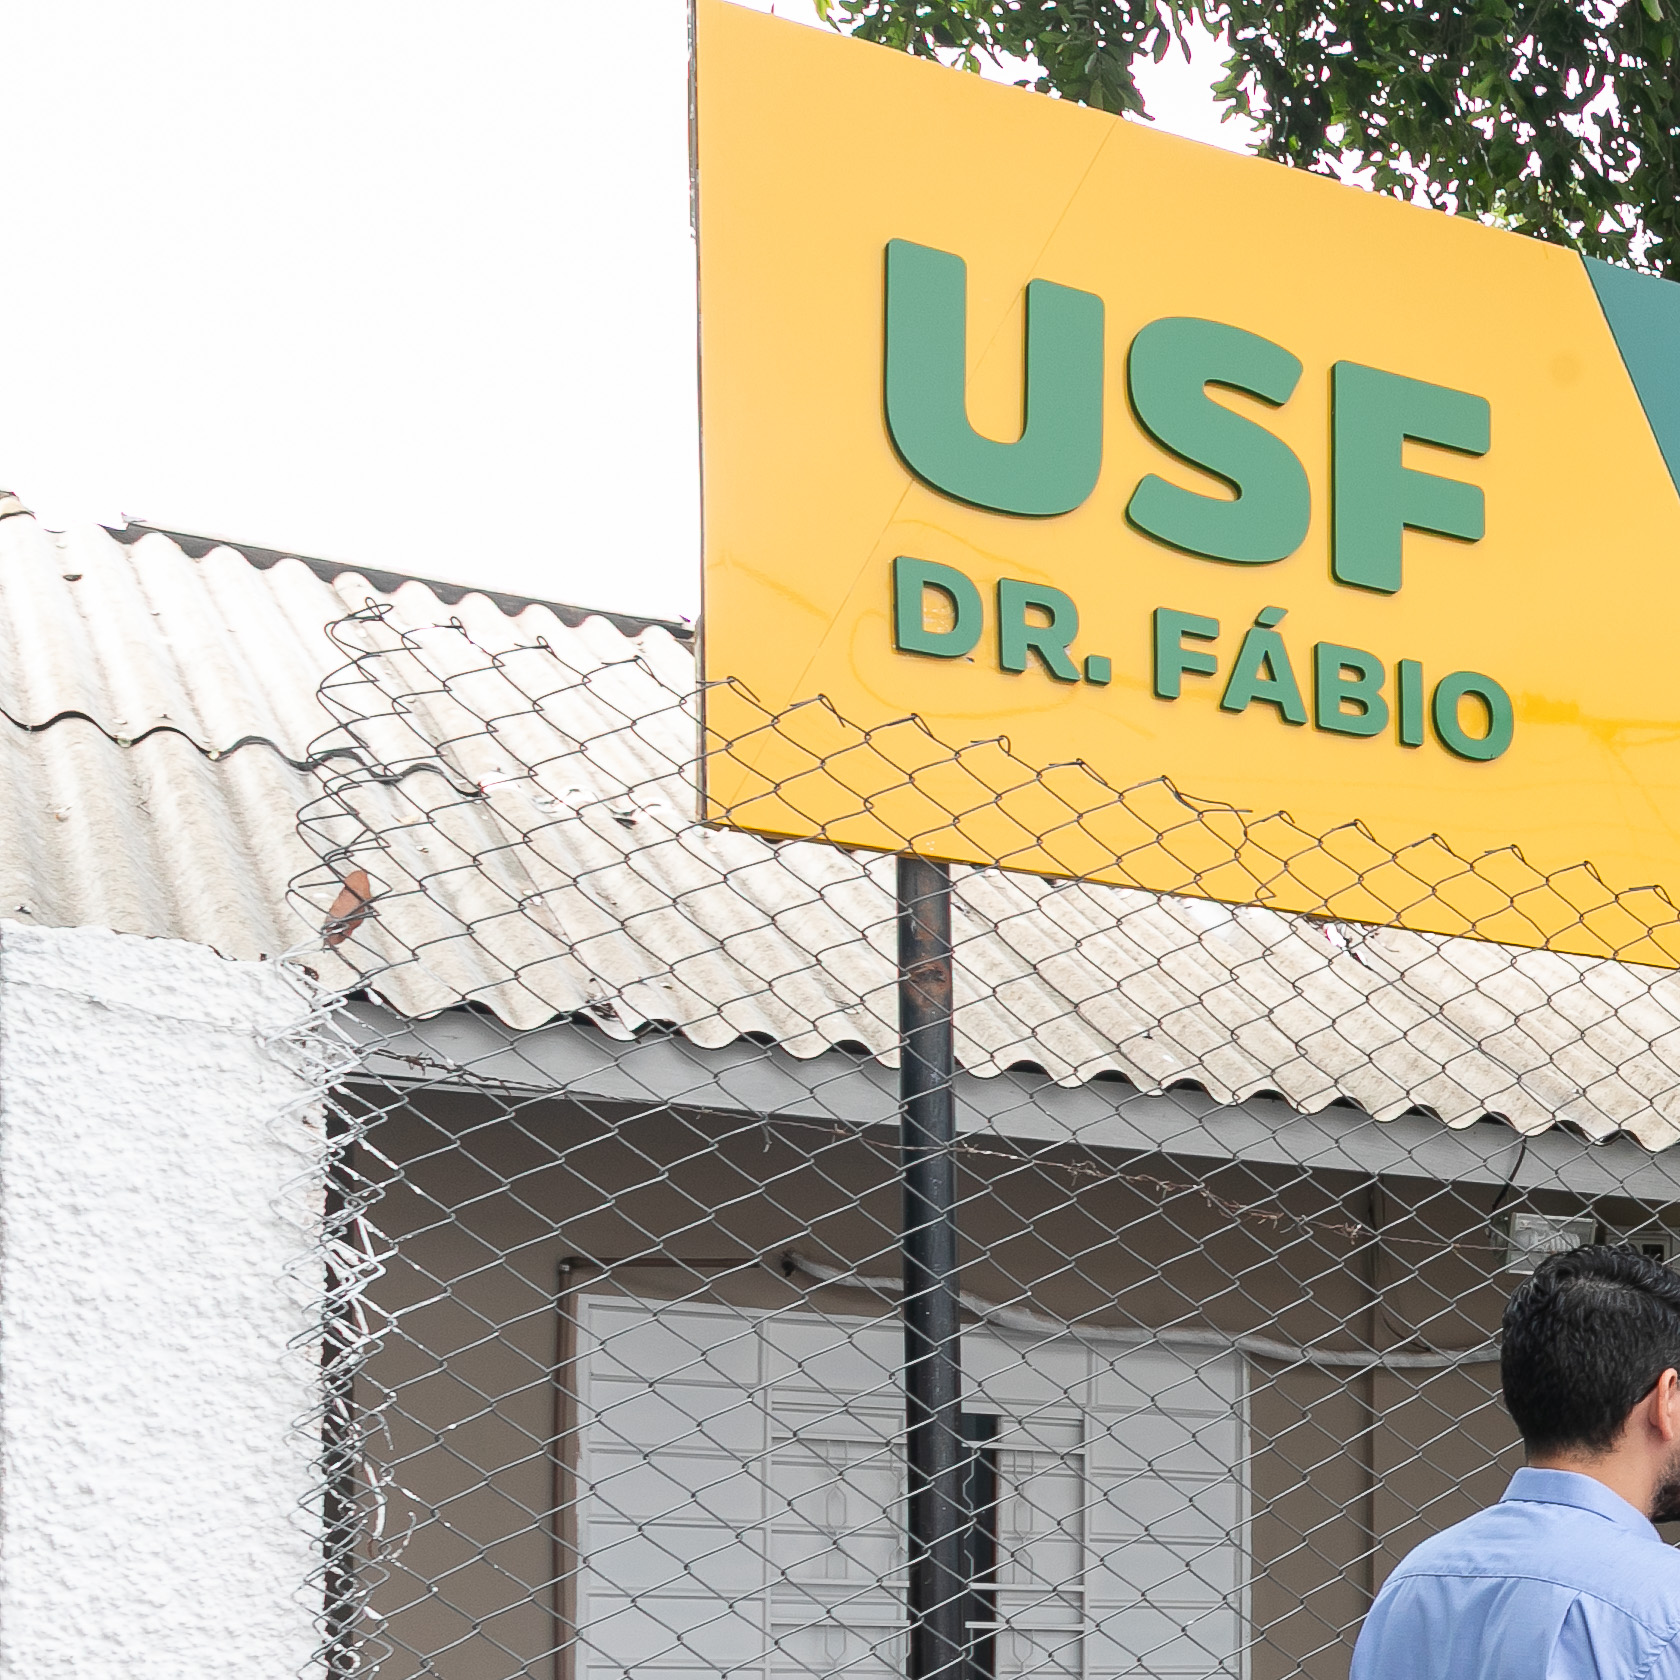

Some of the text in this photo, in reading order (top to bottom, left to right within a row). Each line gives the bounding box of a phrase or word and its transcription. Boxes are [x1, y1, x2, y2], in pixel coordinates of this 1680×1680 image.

[884, 237, 1491, 594] USF
[893, 554, 1515, 762] DR. FÁBIO
